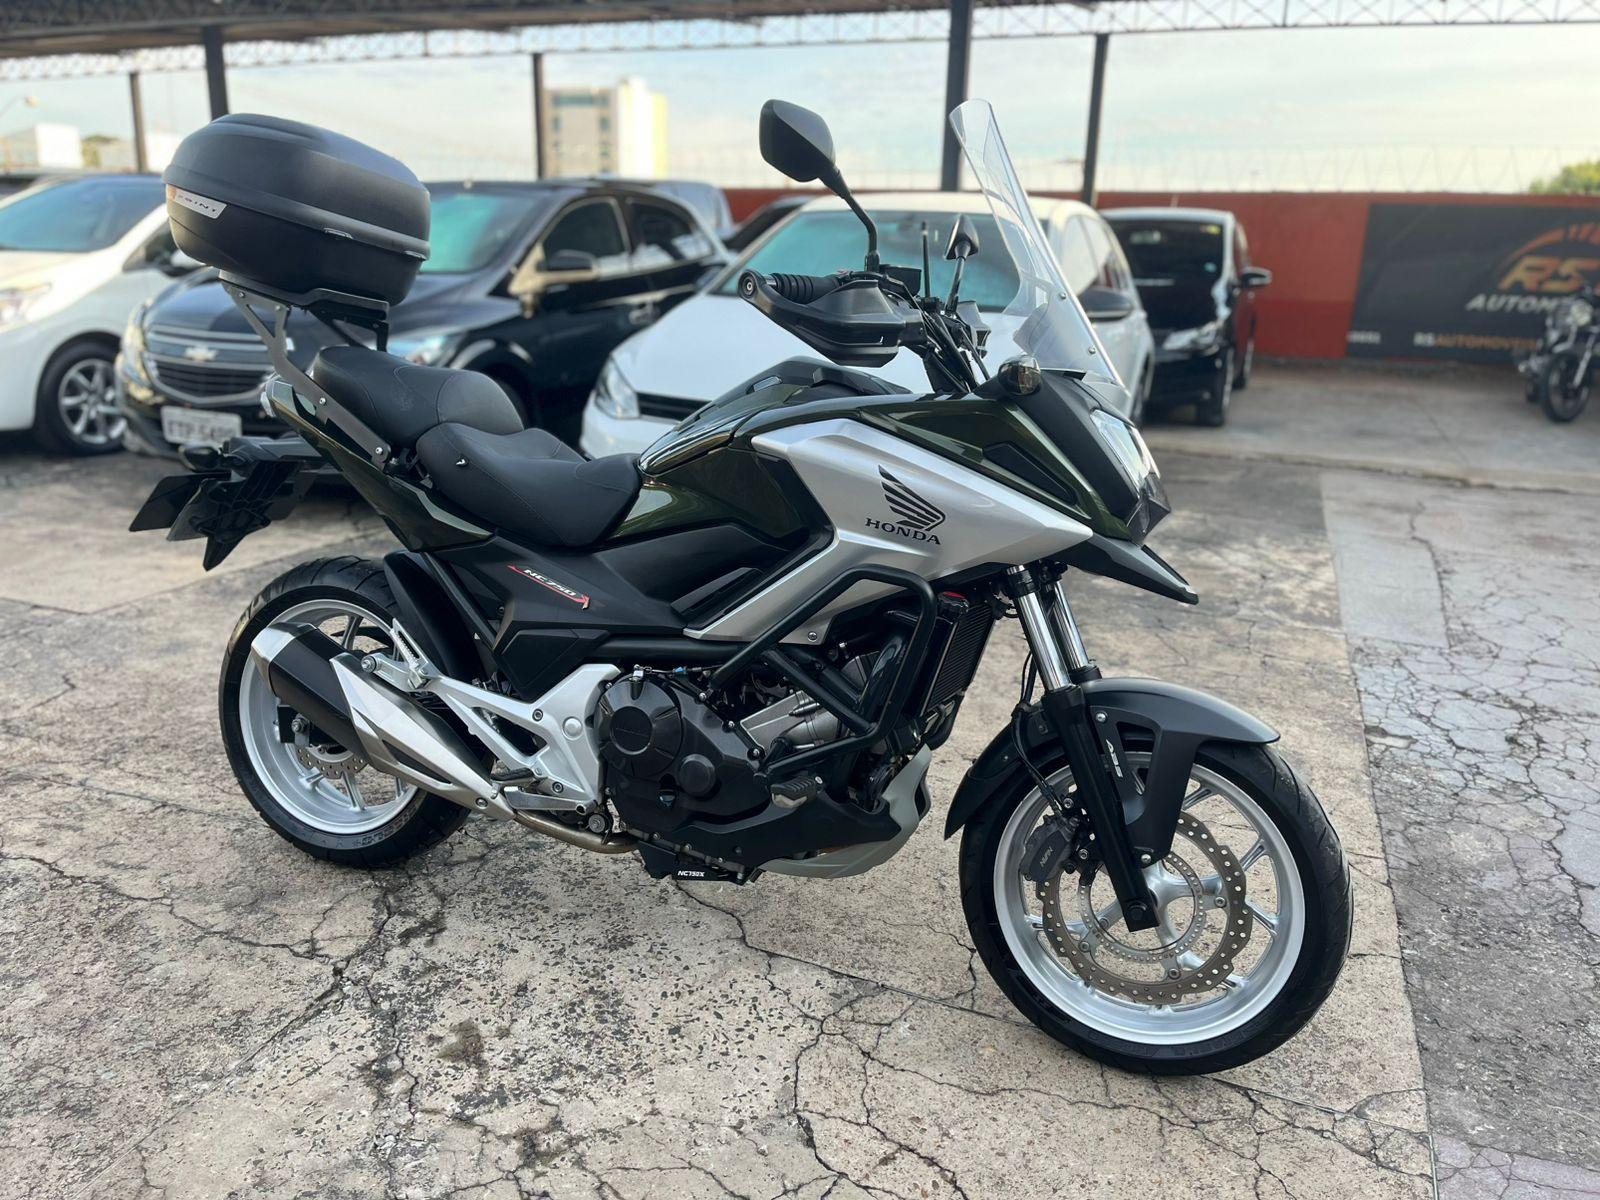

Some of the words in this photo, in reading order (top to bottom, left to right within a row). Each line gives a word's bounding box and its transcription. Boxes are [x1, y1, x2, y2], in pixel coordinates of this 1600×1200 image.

[1498, 256, 1600, 293] RS
[865, 517, 941, 545] HONDA
[677, 870, 706, 878] NC750X
